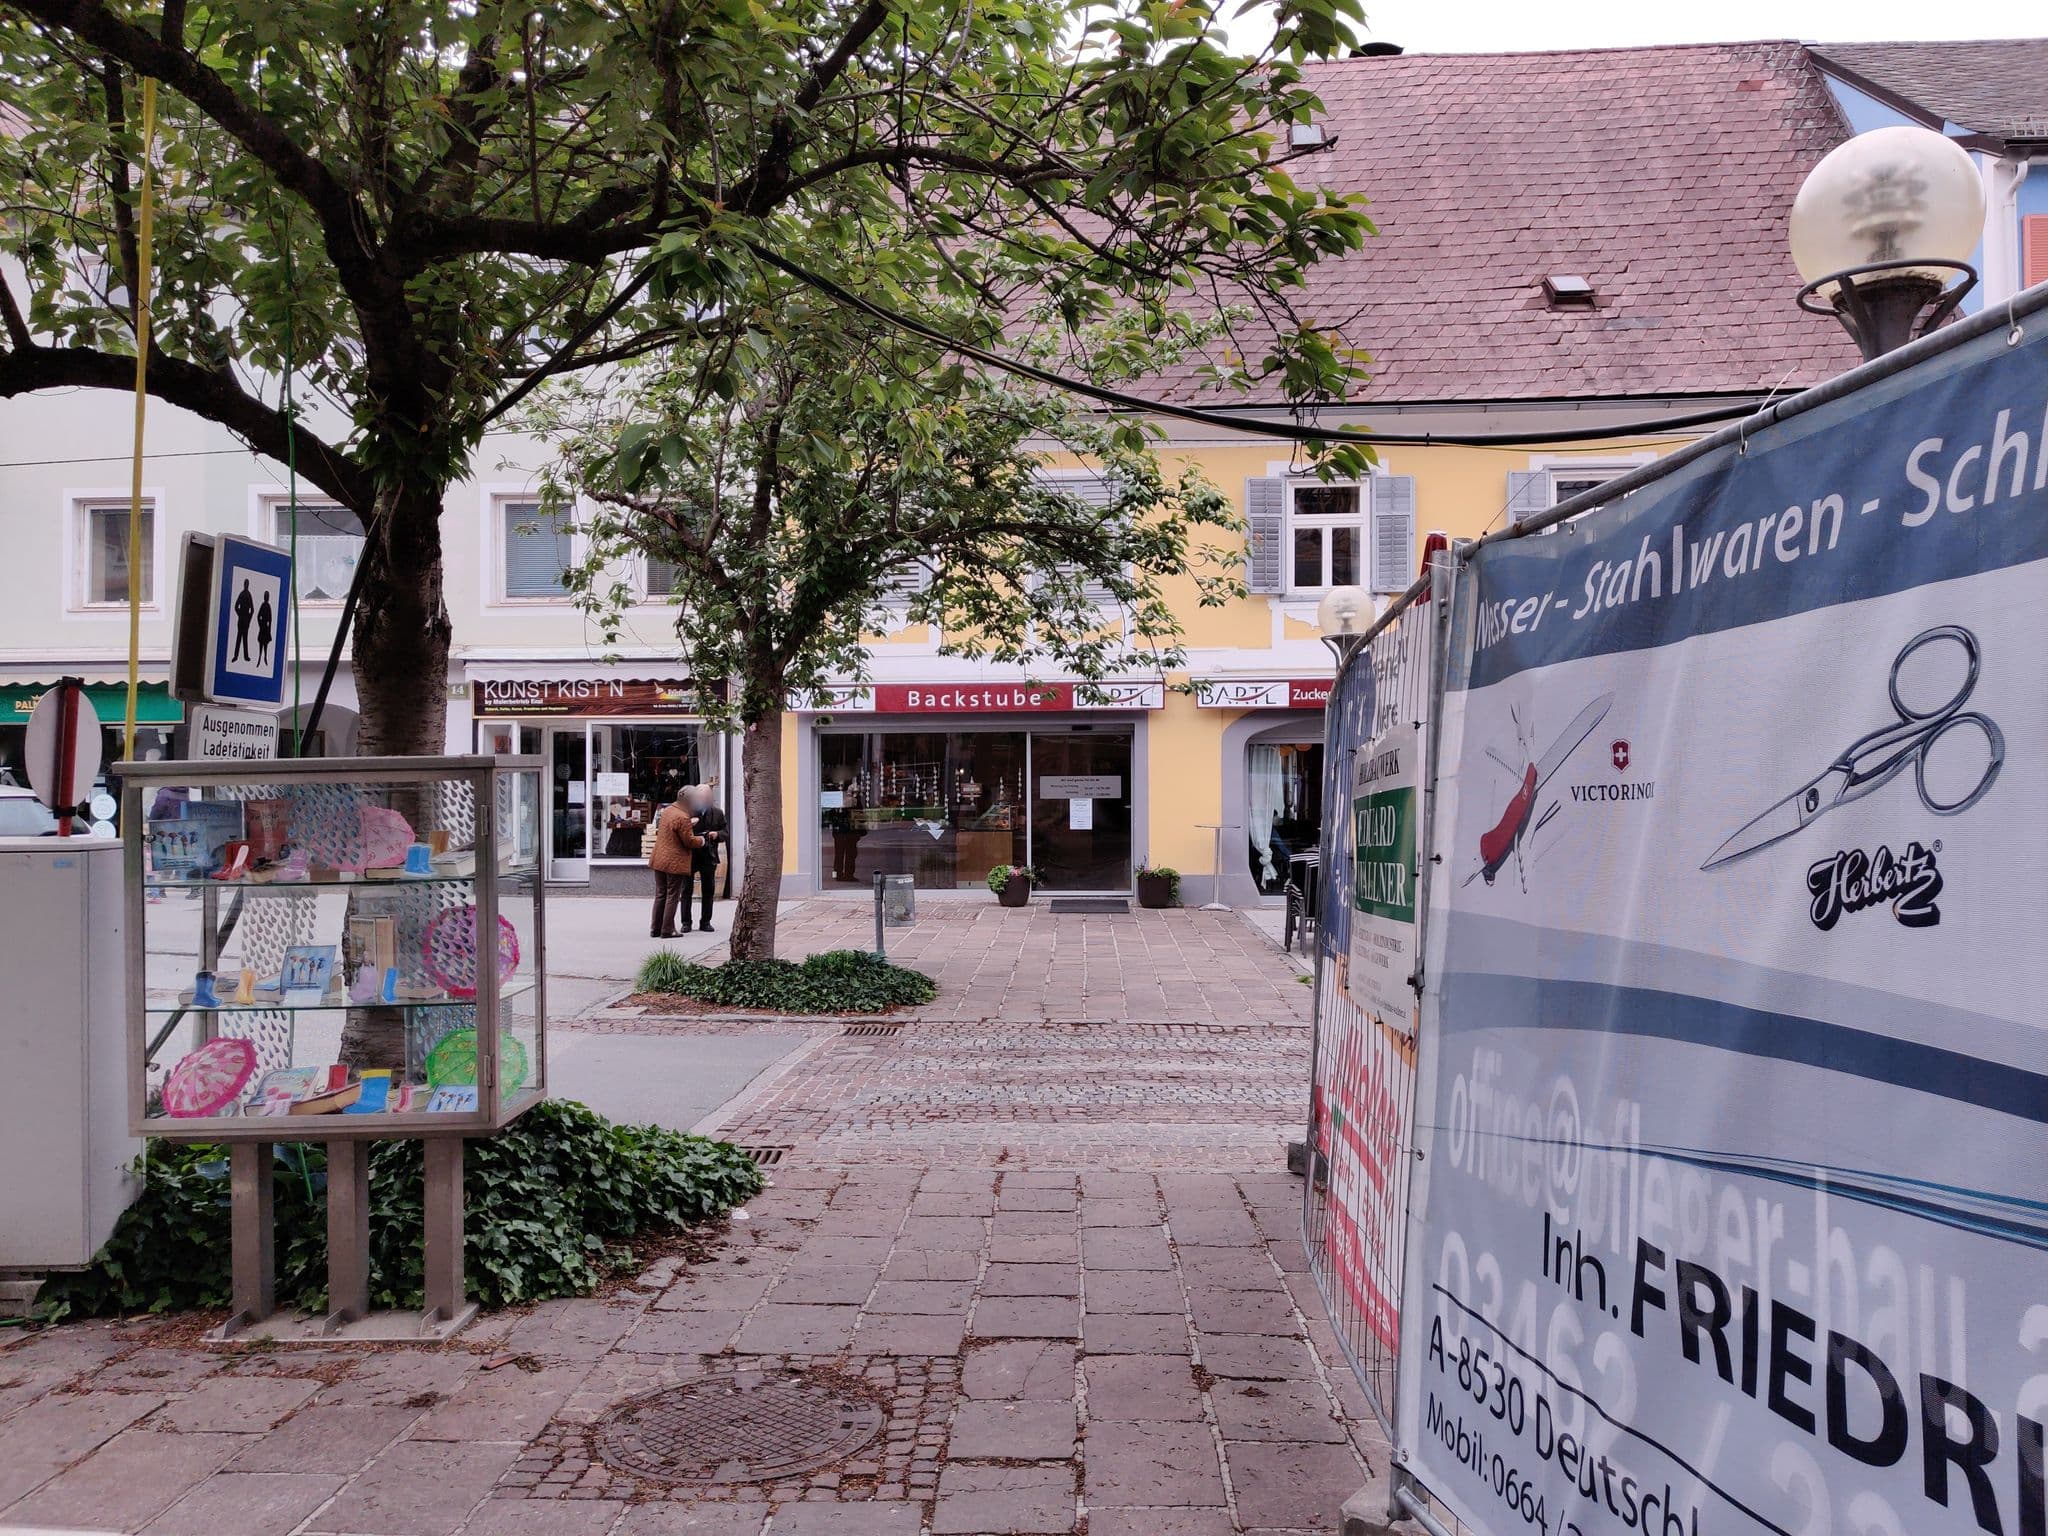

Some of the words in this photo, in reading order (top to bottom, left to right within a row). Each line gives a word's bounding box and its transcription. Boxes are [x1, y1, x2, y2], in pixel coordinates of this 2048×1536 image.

[452, 685, 464, 695] 14
[484, 681, 552, 699] KUNST
[908, 689, 1041, 707] Backstube
[1293, 688, 1330, 700] Zucke
[203, 714, 274, 737] Ausgenommen
[203, 739, 270, 759] Ladetätigkeit
[1358, 804, 1396, 847] EDUARD
[1543, 1211, 1620, 1320] Inh.
[1429, 1315, 1525, 1436] A-8530
